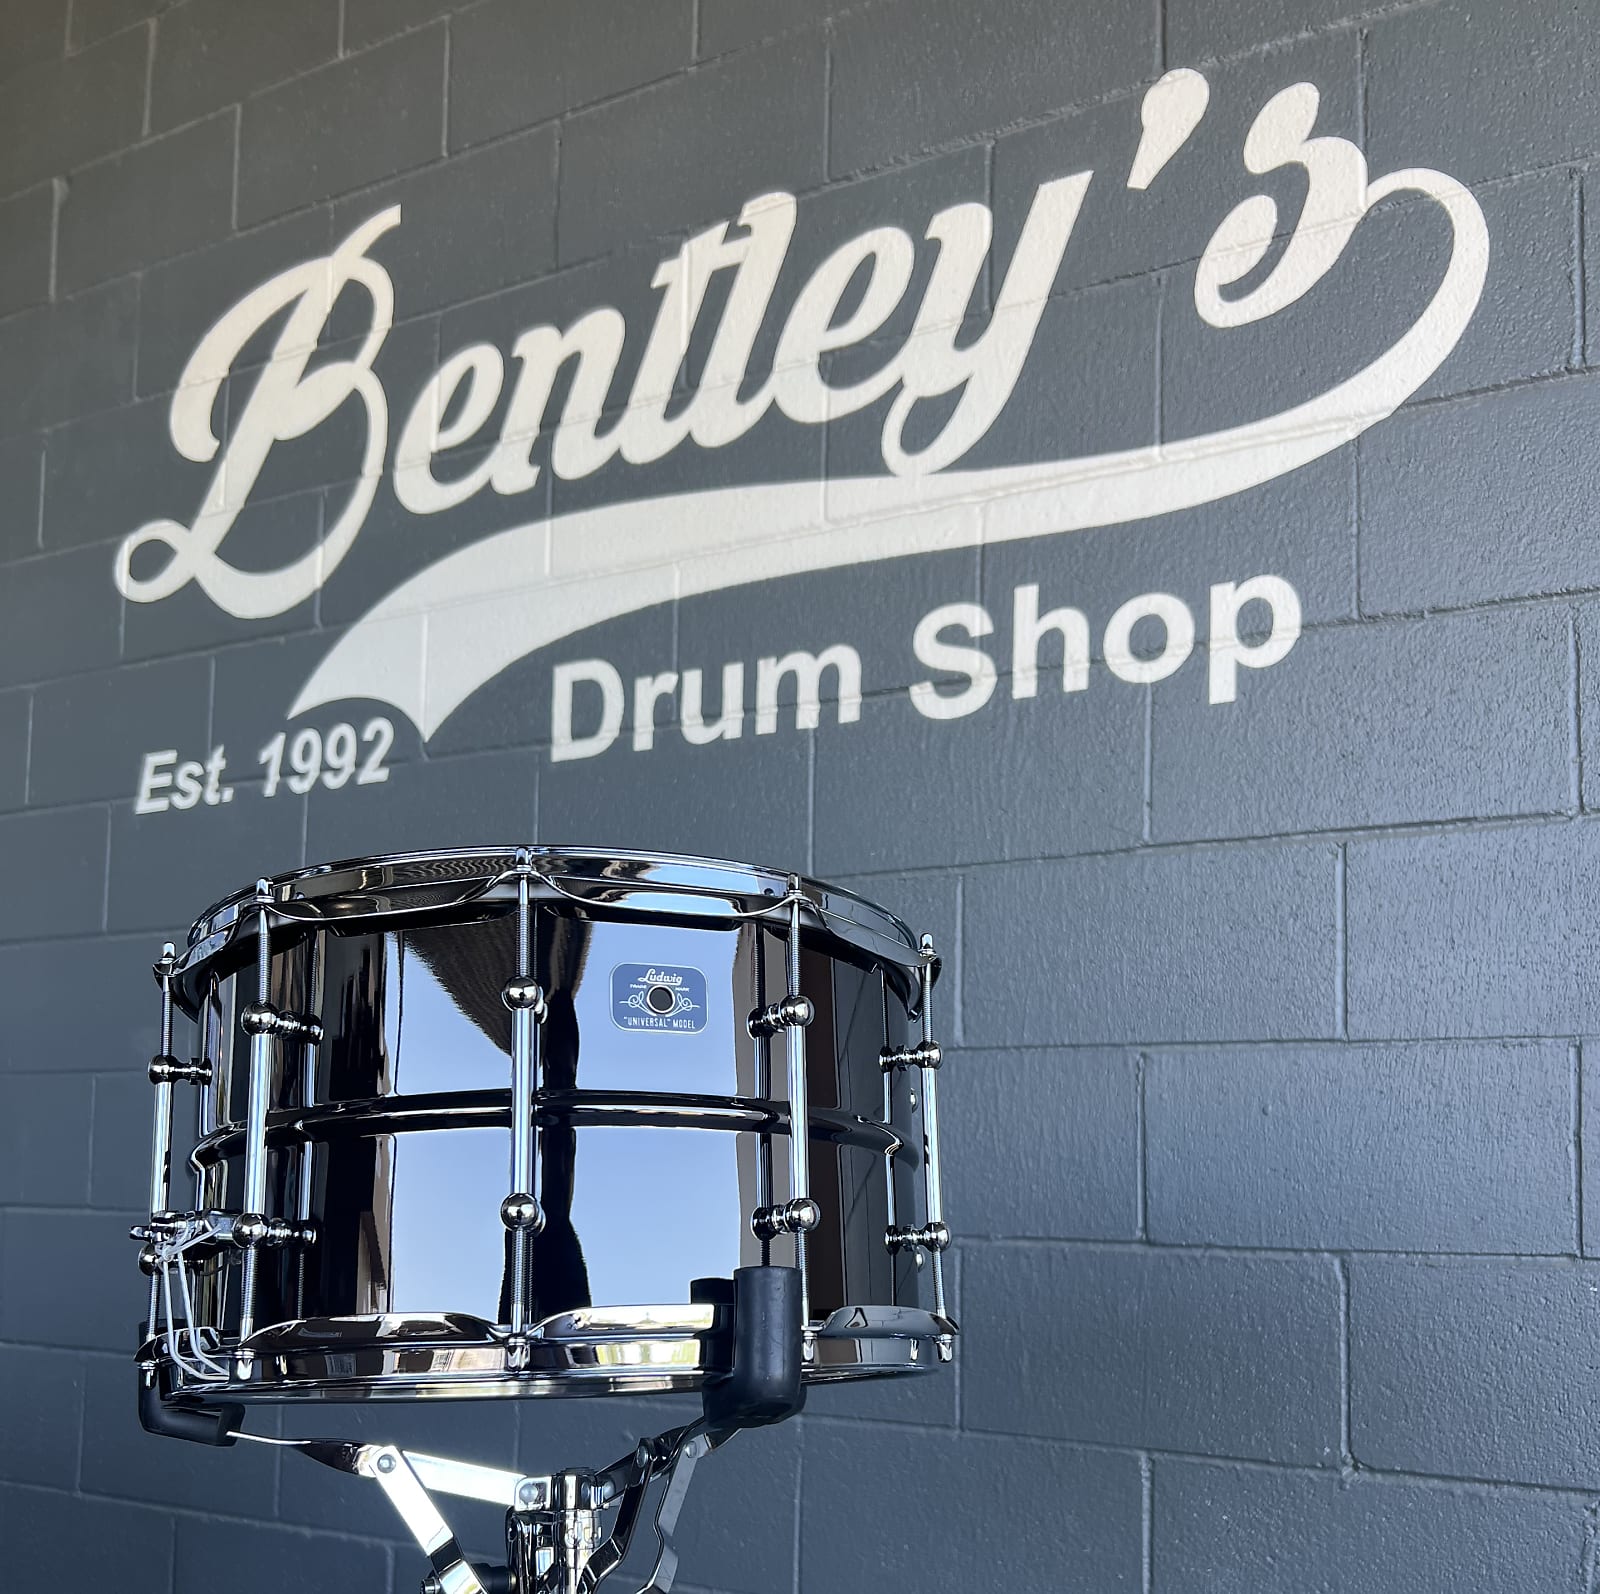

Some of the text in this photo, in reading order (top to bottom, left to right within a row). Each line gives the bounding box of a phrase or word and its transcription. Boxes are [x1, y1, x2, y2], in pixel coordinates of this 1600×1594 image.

[115, 68, 1420, 618] Bentley's
[551, 574, 1303, 763] Drum Shop
[135, 717, 394, 815] Est. 1992
[637, 968, 683, 985] Ludwig
[672, 1019, 696, 1029] MODEL
